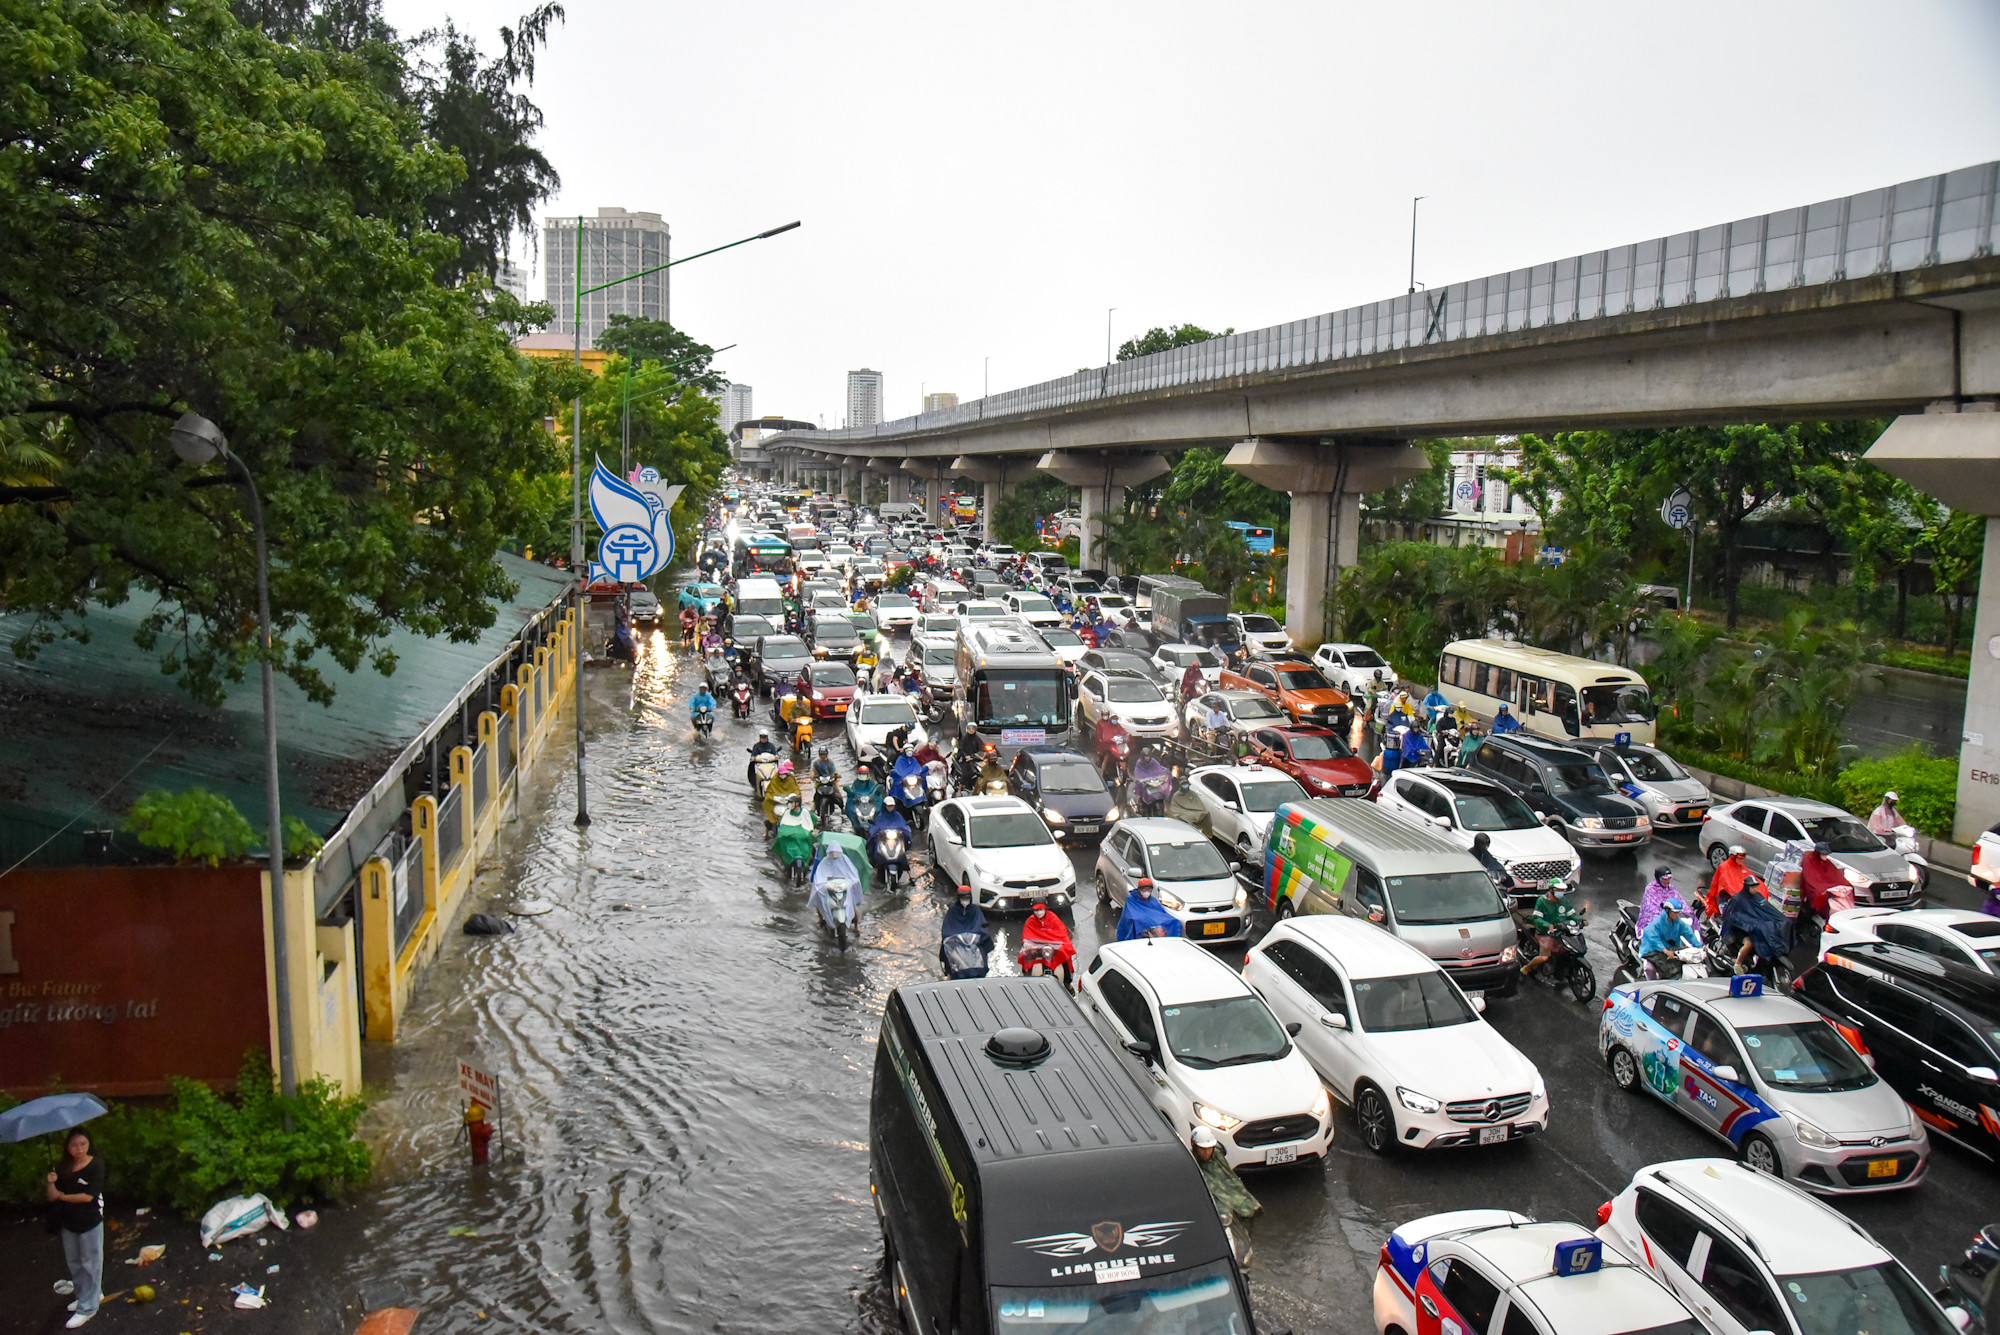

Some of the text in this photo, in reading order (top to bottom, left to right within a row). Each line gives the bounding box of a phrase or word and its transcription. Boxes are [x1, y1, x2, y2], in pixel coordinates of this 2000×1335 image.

[42, 979, 103, 996] Future
[1741, 979, 1756, 995] G7
[125, 998, 159, 1019] lai
[460, 1063, 472, 1079] XE
[907, 1066, 938, 1136] EMPIRE
[1698, 1089, 1718, 1108] TAXI
[1916, 1083, 1978, 1119] XPANDER
[1482, 1134, 1505, 1144] 987.52
[1270, 1154, 1294, 1163] 724.95
[1275, 1147, 1288, 1155] 30G
[1050, 1253, 1176, 1277] LIMOUSINE
[1571, 1247, 1593, 1271] G7
